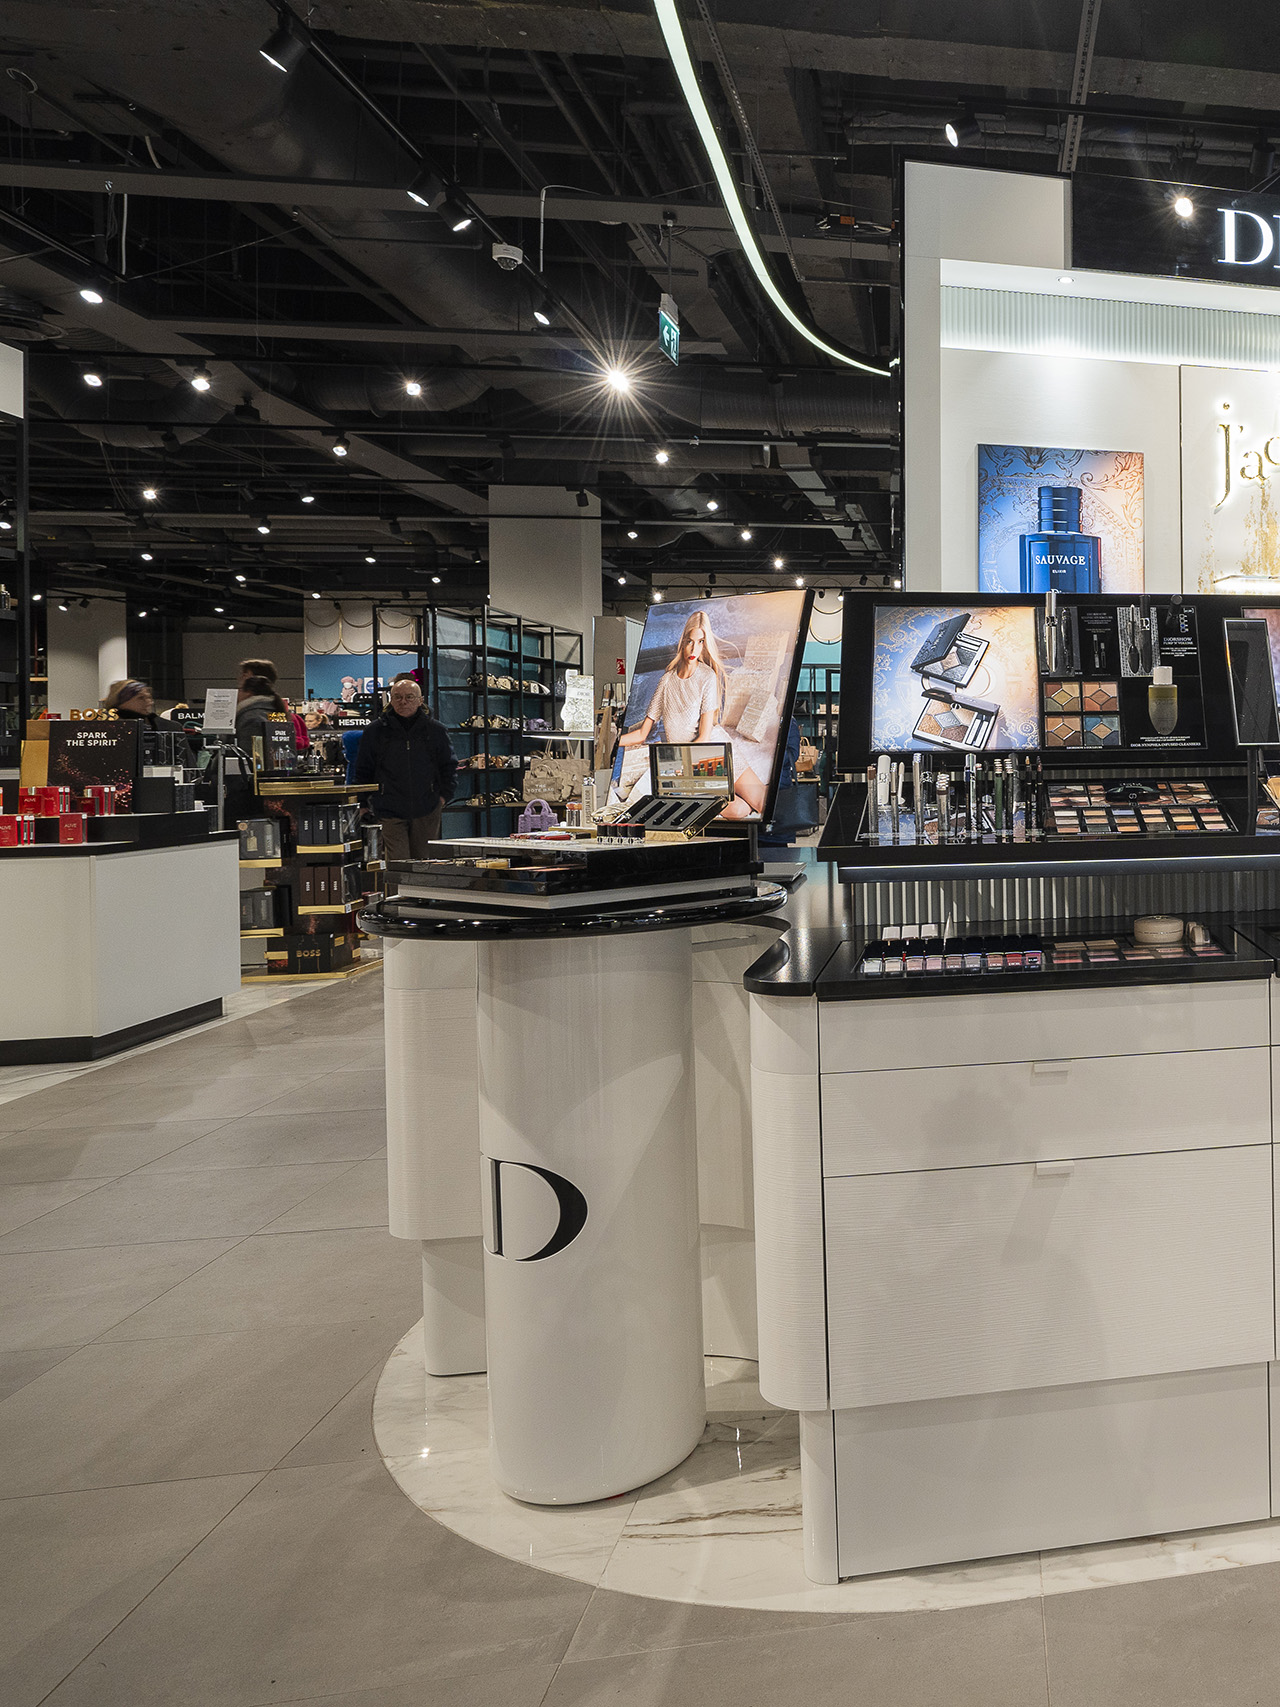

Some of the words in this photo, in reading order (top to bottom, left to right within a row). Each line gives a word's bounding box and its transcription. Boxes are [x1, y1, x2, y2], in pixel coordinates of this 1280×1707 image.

[1035, 555, 1086, 566] SAUVAGE
[69, 708, 119, 721] BOSS
[296, 950, 321, 958] BOSS
[487, 1157, 587, 1262] D
